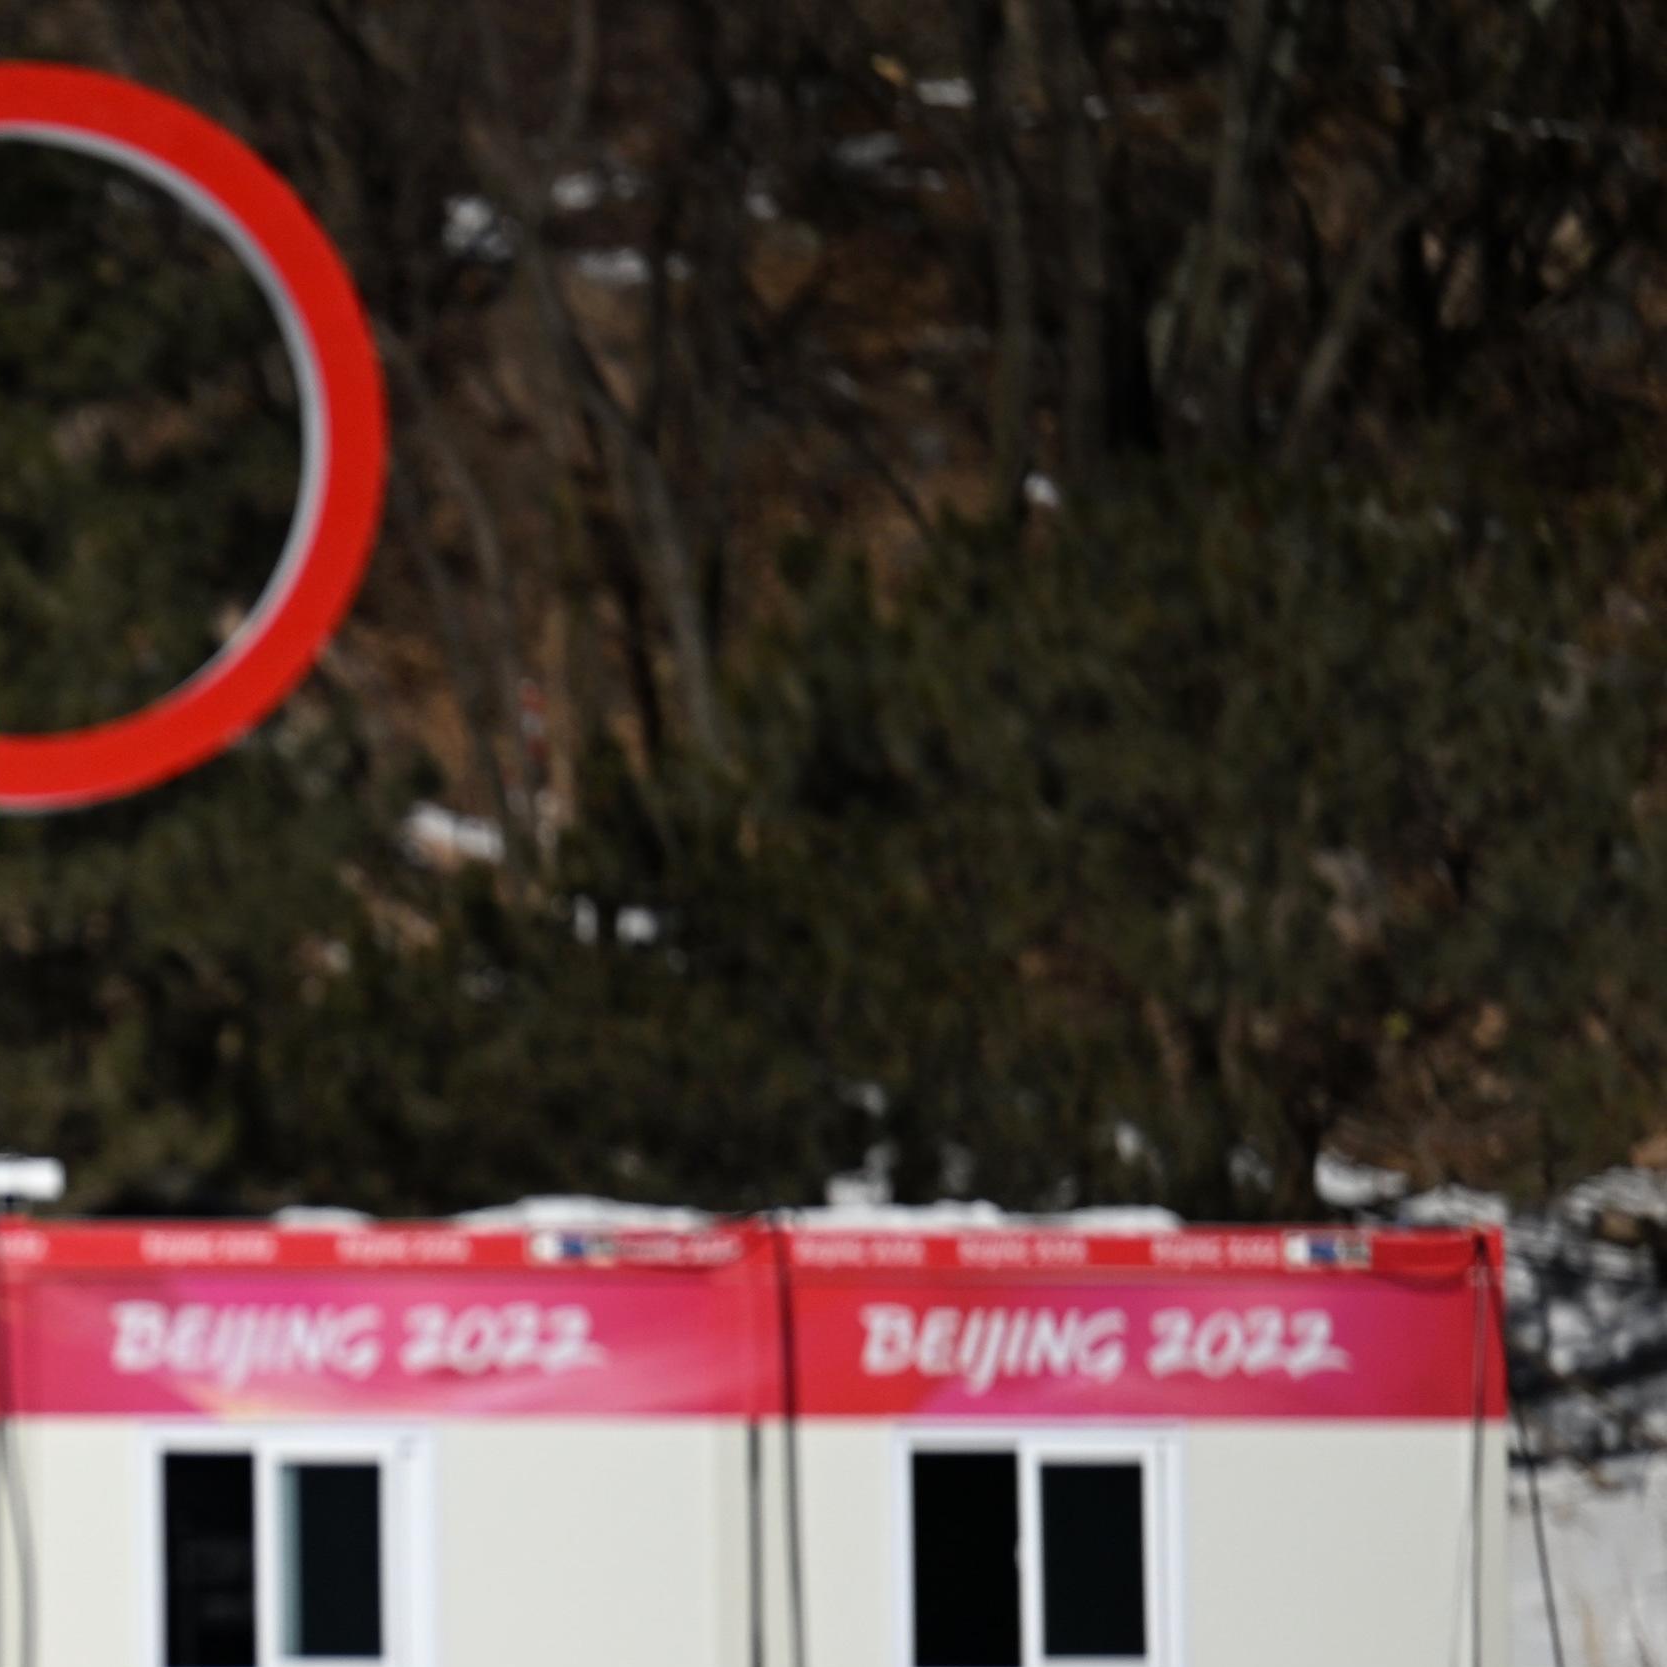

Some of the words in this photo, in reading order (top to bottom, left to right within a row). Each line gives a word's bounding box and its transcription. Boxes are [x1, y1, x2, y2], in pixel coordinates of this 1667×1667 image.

[109, 1299, 382, 1387] BEIJING
[399, 1301, 604, 1376] 2022
[859, 1303, 1125, 1395] BEIJING
[1146, 1307, 1349, 1377] 2022
